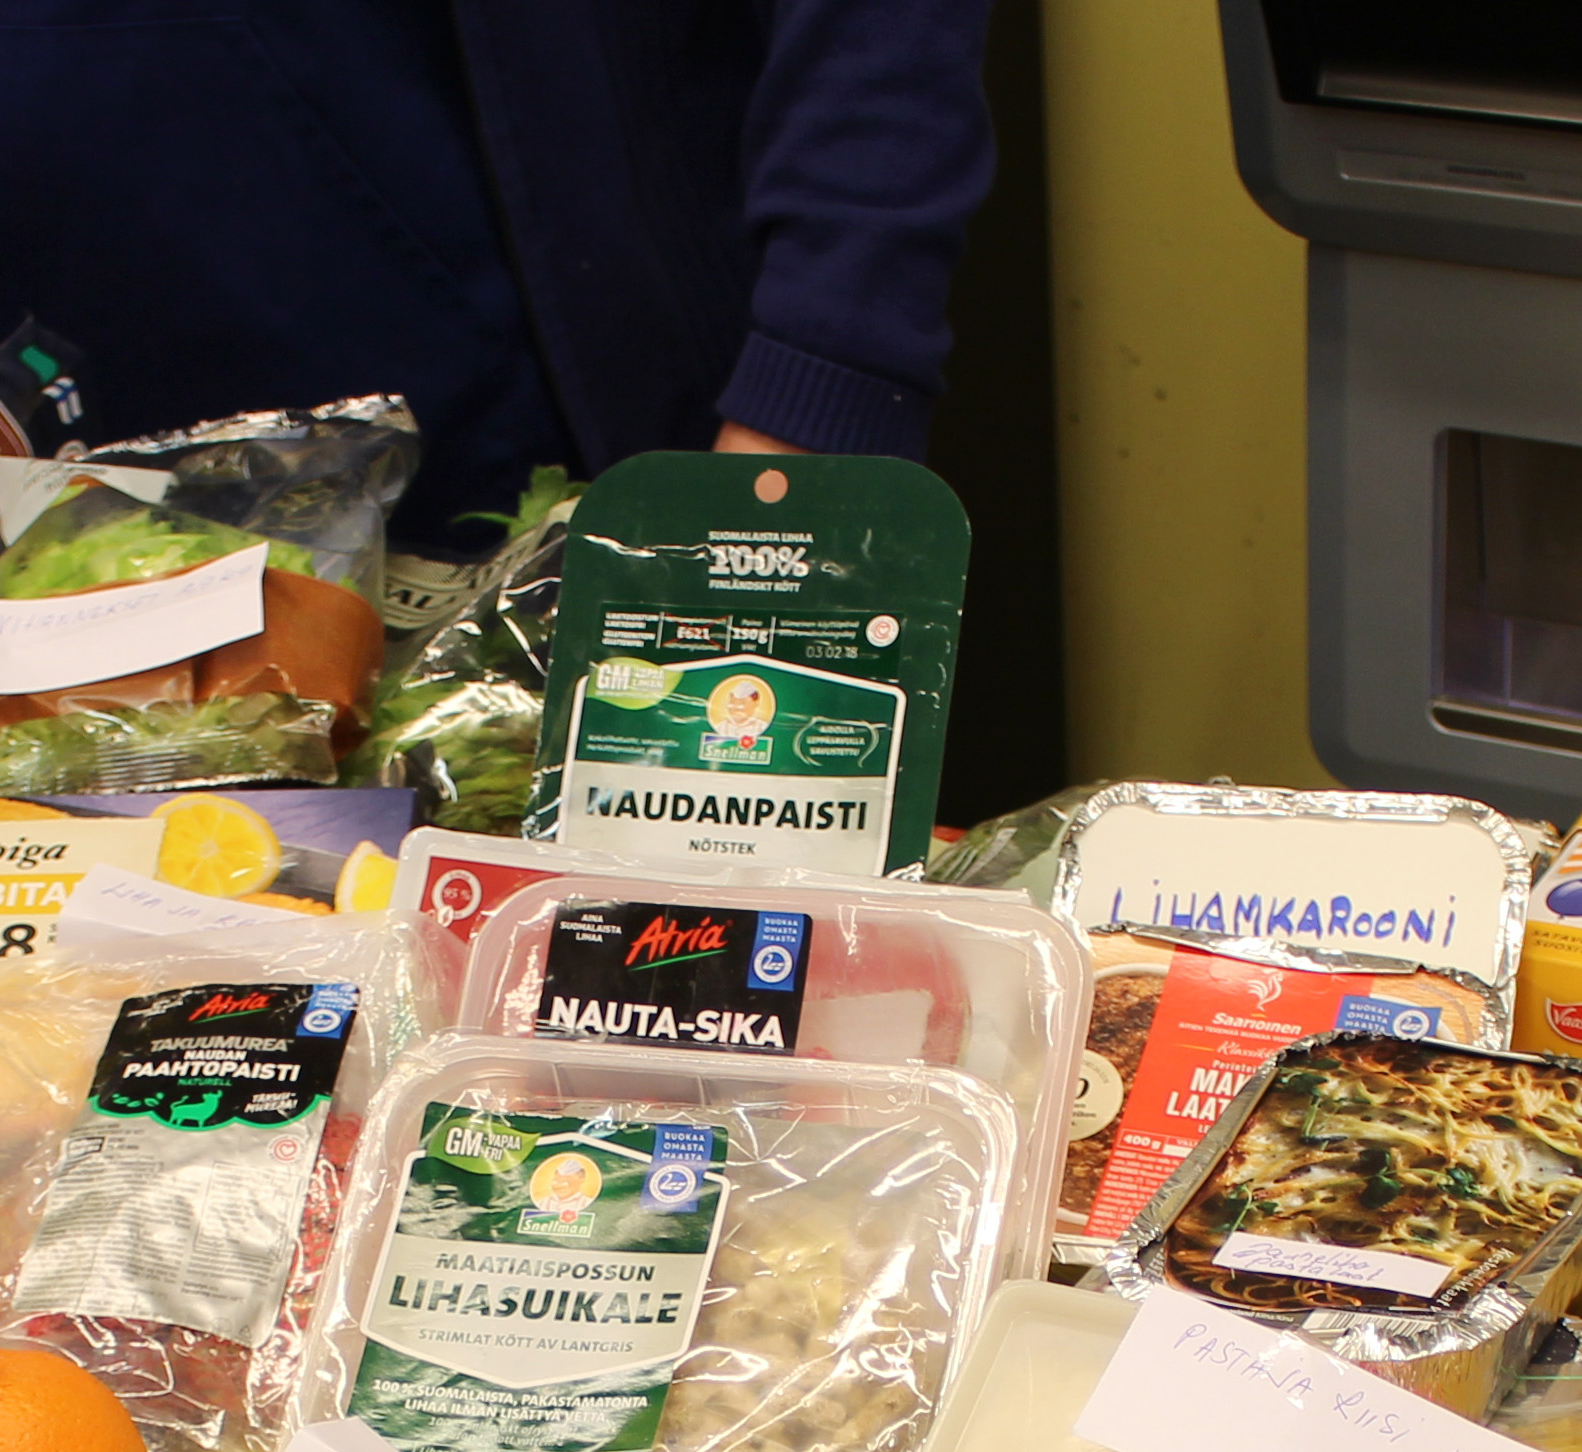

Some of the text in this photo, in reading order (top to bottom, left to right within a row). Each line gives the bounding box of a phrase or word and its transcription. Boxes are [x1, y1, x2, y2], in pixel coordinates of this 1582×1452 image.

[704, 743, 768, 760] Snellman
[587, 785, 869, 831] NAUDANPAISTI
[688, 837, 757, 856] NÖTSTEK
[580, 913, 604, 923] AINA
[763, 915, 799, 928] RUOKAA
[559, 920, 624, 936] SUOMALAISTA
[763, 925, 800, 936] OMASTA
[575, 932, 604, 943] LIHAA
[625, 914, 726, 966] Atria
[761, 933, 799, 944] MAASTA
[188, 991, 276, 1022] Atria
[1348, 1001, 1391, 1017] RUOKAA
[548, 996, 787, 1050] NAUTA-SIKA
[1211, 1011, 1302, 1037] Saarioinen
[1346, 1010, 1389, 1026] OMASTA
[183, 1049, 247, 1063] NAUDAN
[123, 1060, 302, 1083] PAAHTOPAISTI
[177, 1077, 233, 1087] NATURELL
[444, 1126, 483, 1161] GM
[664, 1131, 707, 1143] RUOKAA
[660, 1150, 704, 1161] MAASTA
[662, 1141, 707, 1152] OMASTA
[522, 1217, 592, 1237] Snellman
[435, 1252, 656, 1283] MAATIAISPOSSUN
[388, 1275, 684, 1325] LIHASUIKALE
[418, 1327, 634, 1353] STRIMLAT KÖTT AV LANTGRIS
[372, 1379, 649, 1408] 100 SUOMALAISTA, PAKASTAMATONTA
[403, 1398, 449, 1415] LIHAA
[450, 1402, 498, 1419] ILMAN
